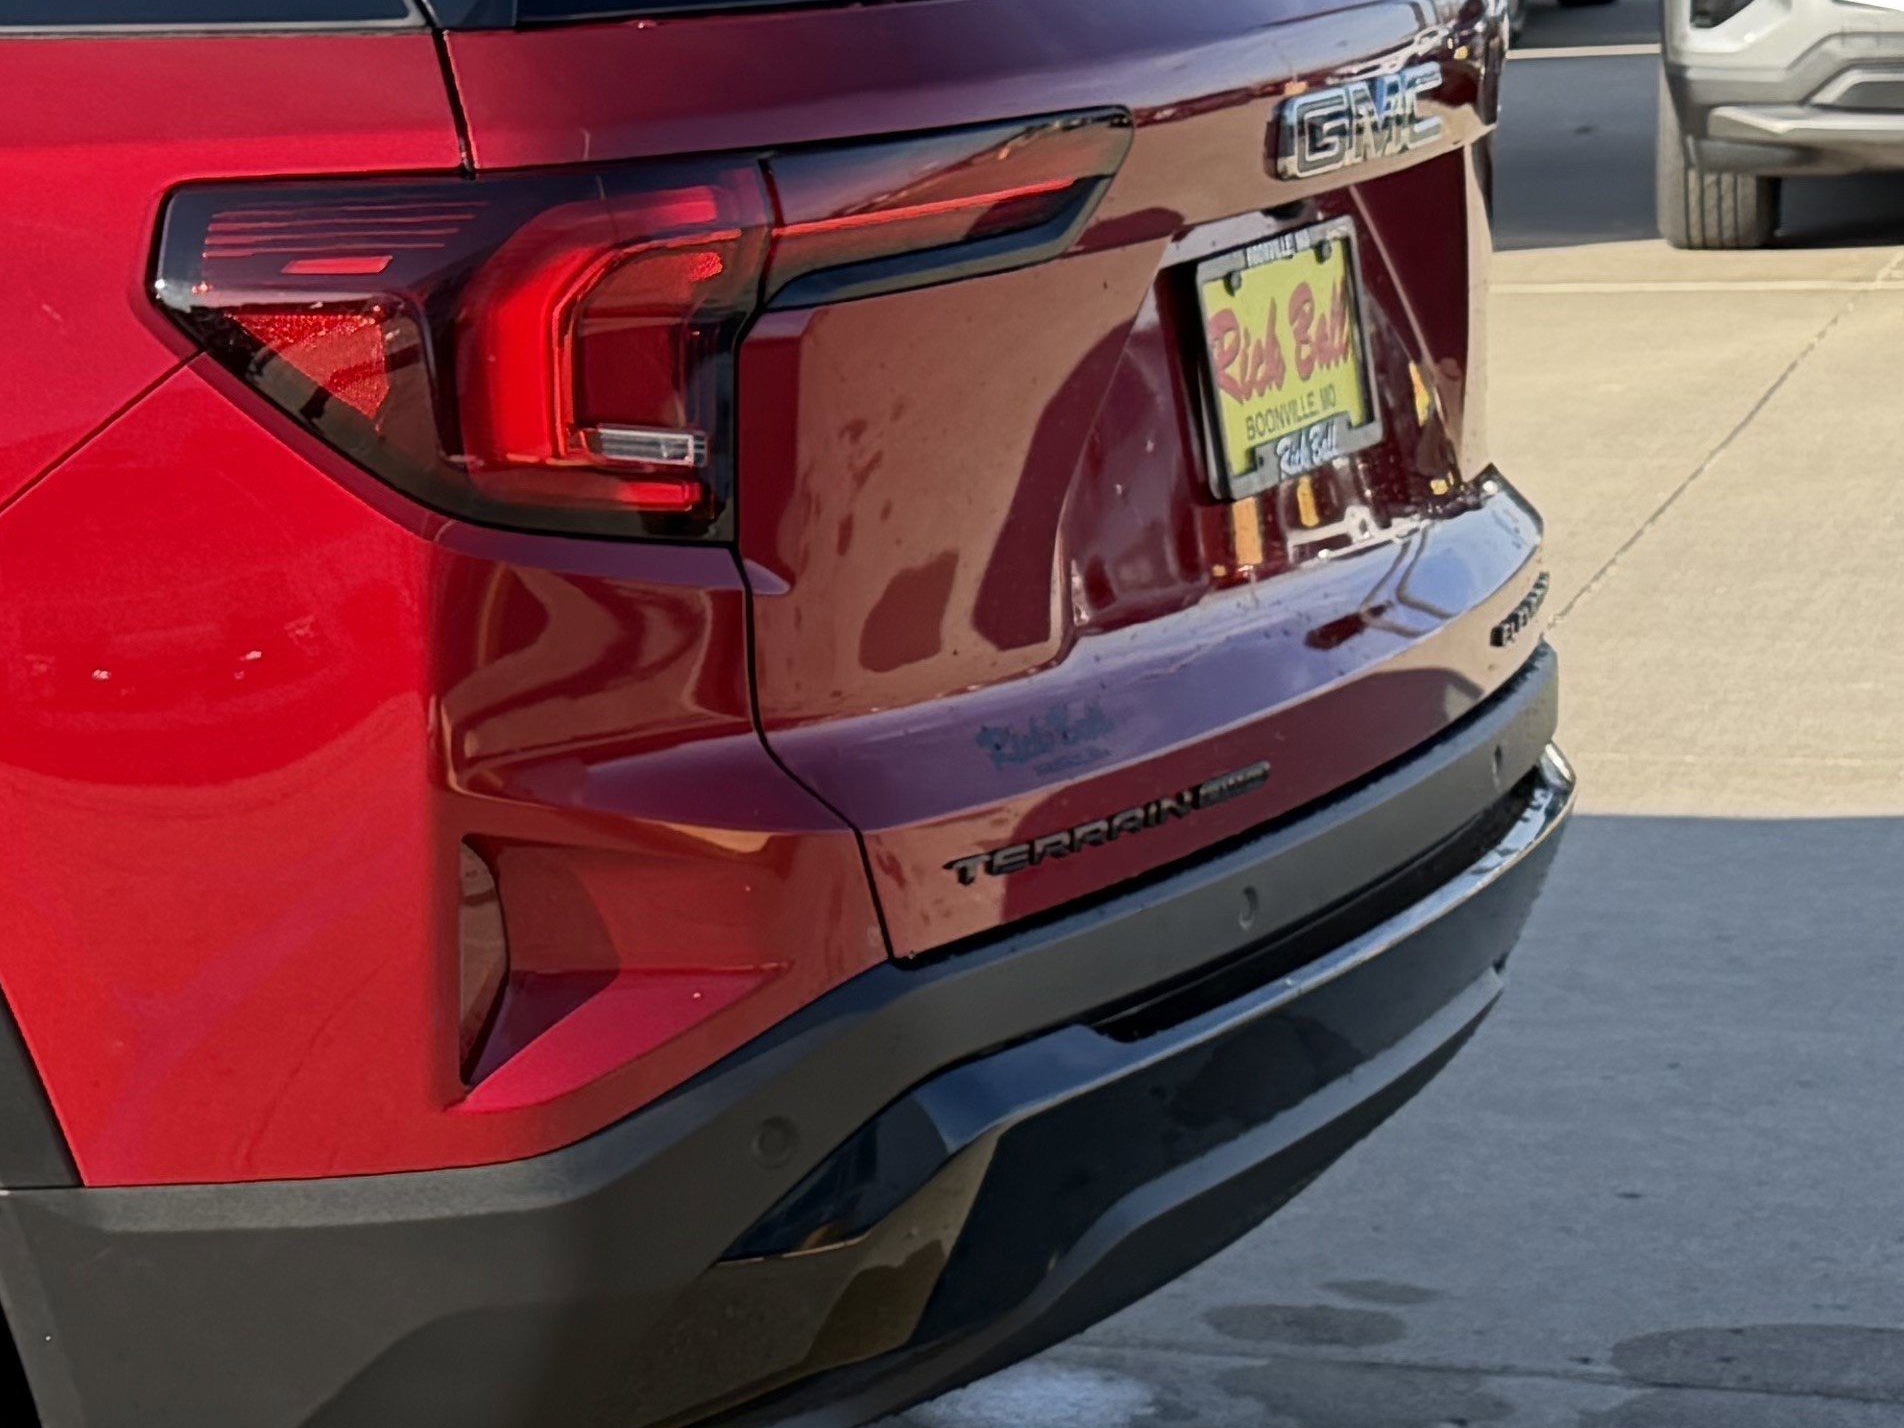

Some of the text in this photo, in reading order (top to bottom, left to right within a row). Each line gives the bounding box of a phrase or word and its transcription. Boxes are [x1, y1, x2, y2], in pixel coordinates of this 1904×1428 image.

[1277, 60, 1444, 180] GMC
[1209, 277, 1350, 404] Rick Ball
[943, 784, 1200, 886] TERRAIN
